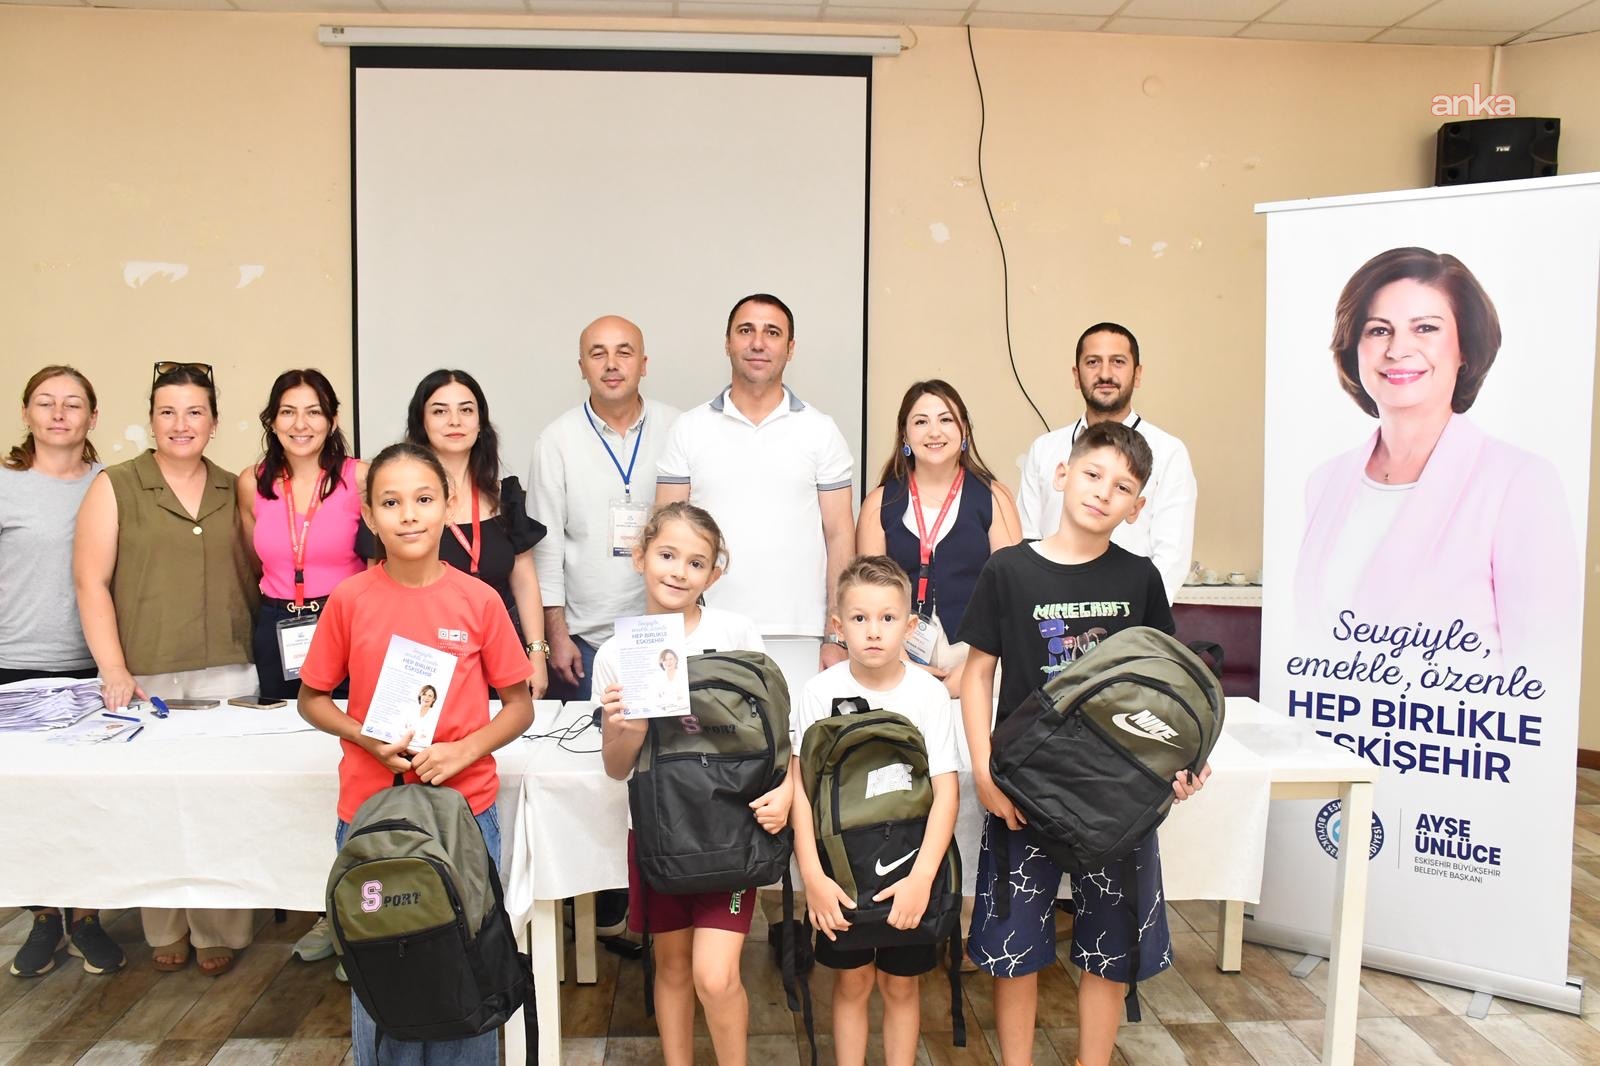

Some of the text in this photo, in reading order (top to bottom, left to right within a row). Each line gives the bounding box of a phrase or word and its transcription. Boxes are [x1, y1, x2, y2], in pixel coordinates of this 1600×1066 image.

[1033, 602, 1130, 620] MINECRAFT
[1333, 610, 1492, 661] Sevgiyle,
[1287, 651, 1546, 700] emekle, özenle
[1128, 709, 1179, 740] NIKE
[1288, 689, 1542, 747] HEP BİRLİKLE
[1315, 730, 1511, 784] SKİŞEHİR
[1415, 813, 1471, 838] AYŞE
[1415, 830, 1502, 866] ÜNLÜCE
